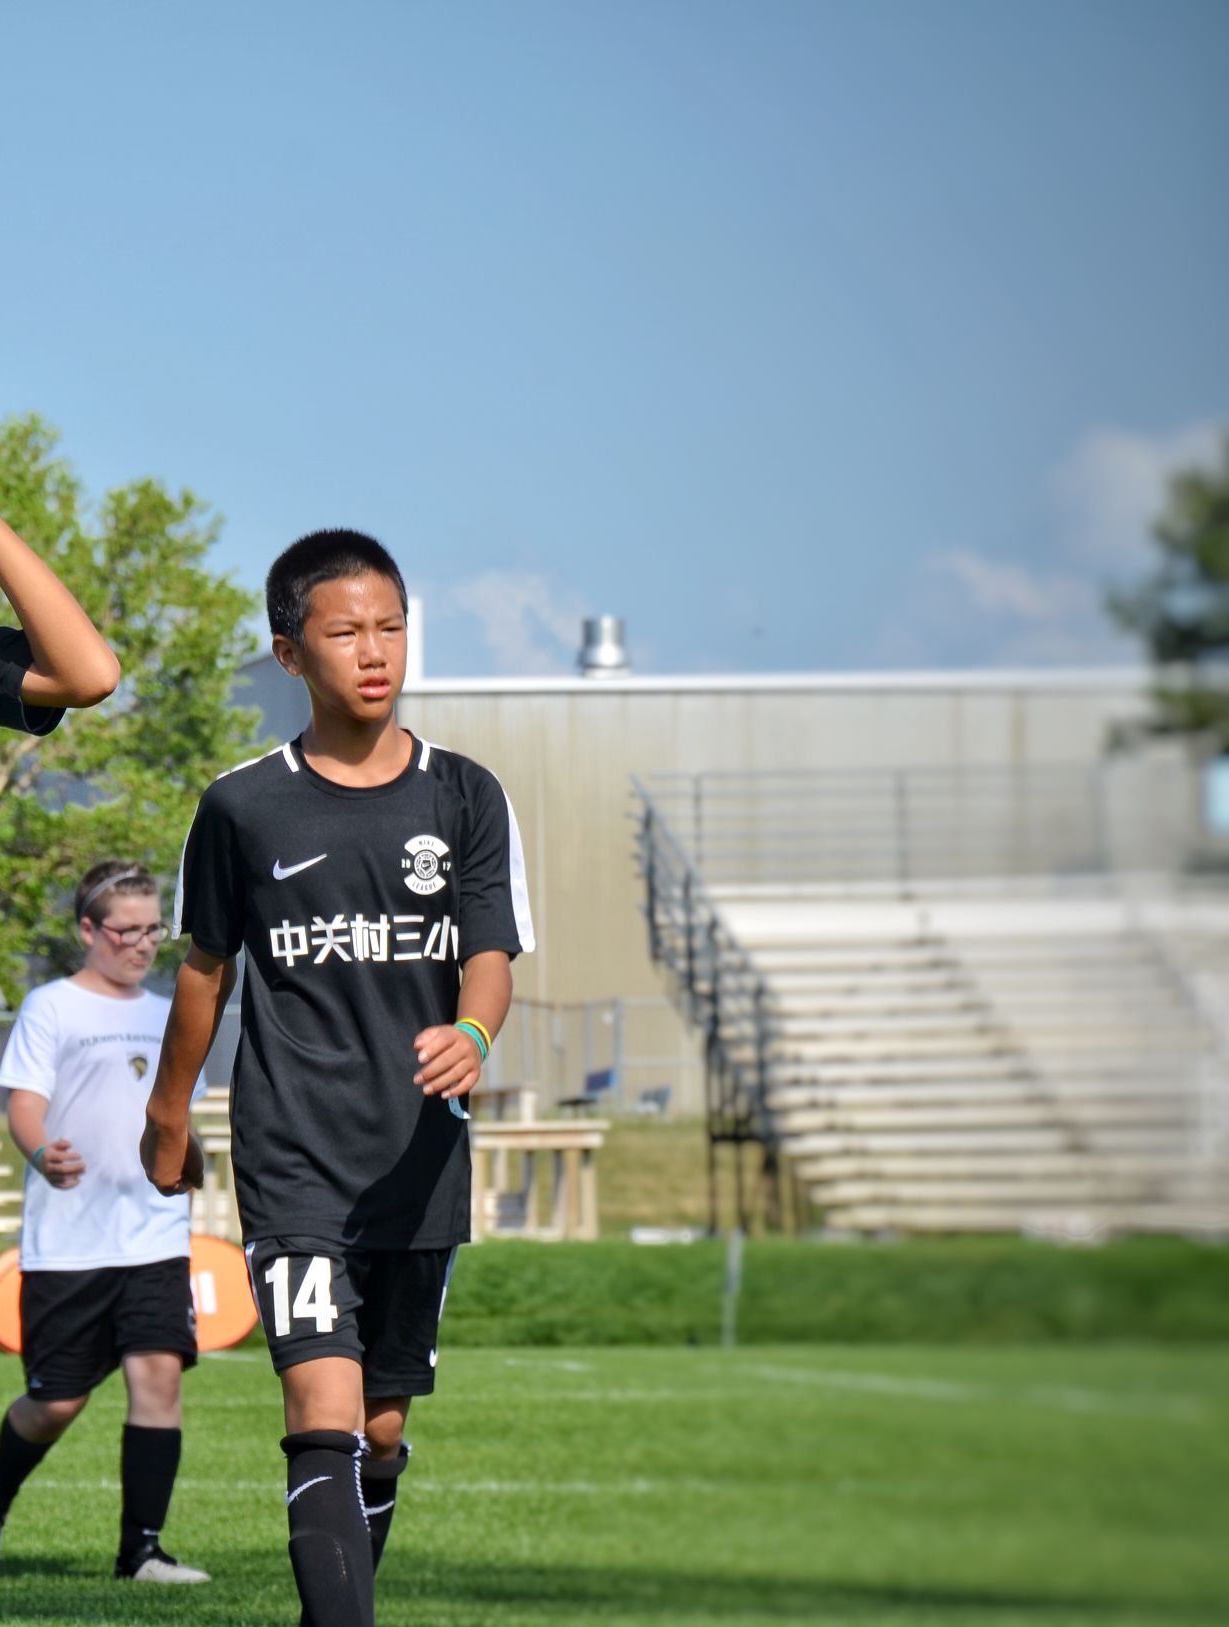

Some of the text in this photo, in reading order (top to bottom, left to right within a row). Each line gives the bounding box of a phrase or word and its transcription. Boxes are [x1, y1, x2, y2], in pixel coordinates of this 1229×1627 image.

[269, 913, 459, 968] 中关村三小
[265, 1255, 339, 1337] 14
